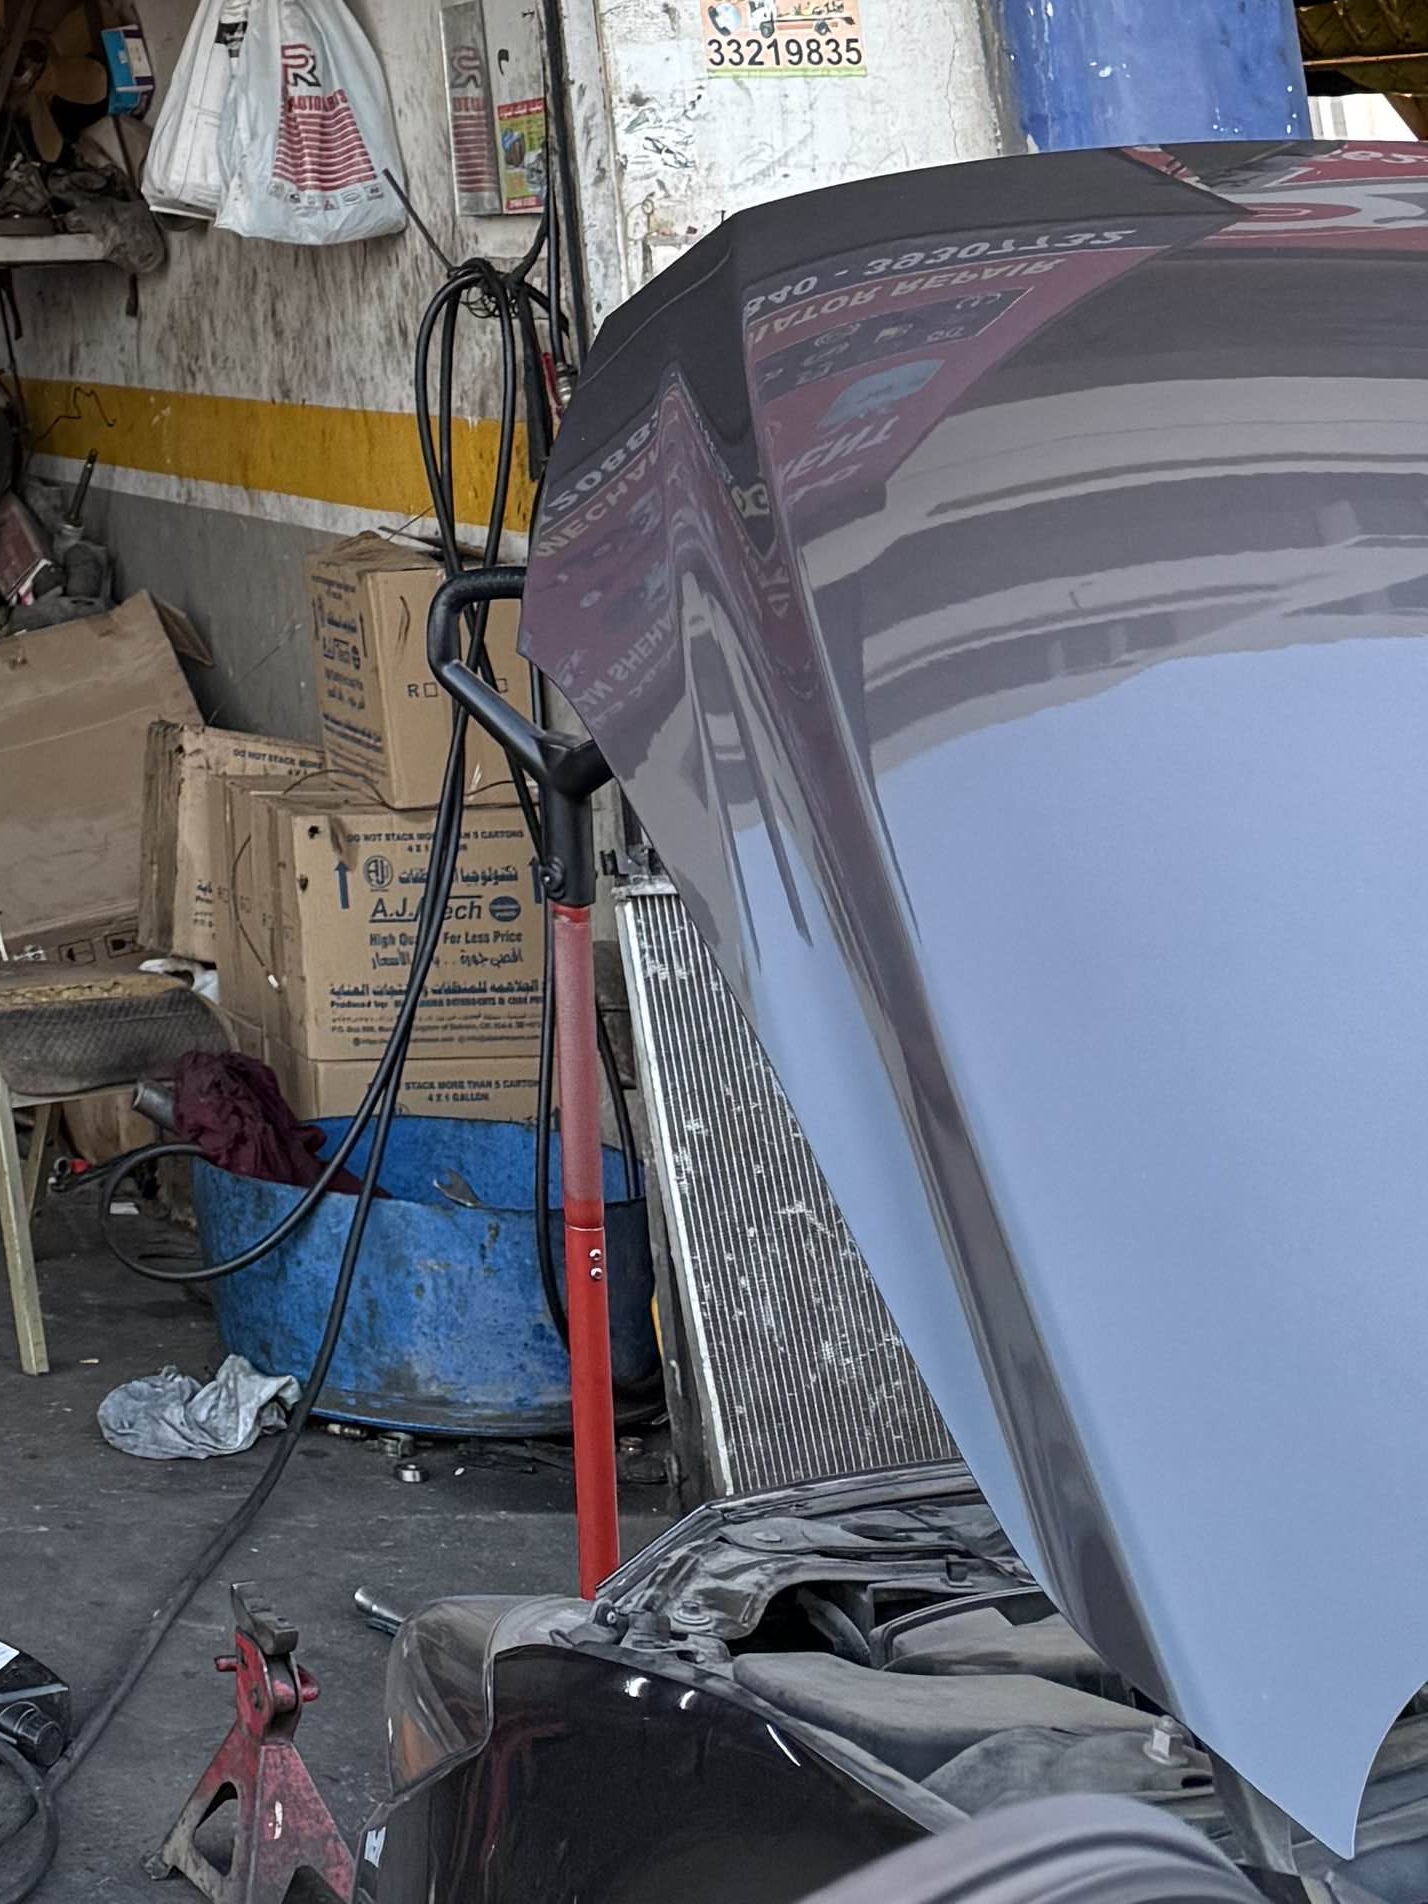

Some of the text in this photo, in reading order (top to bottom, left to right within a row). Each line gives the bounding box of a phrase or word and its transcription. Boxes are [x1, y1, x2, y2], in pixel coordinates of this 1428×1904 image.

[707, 38, 863, 67] 33219835
[369, 932, 395, 947] High
[464, 931, 491, 944] Less
[493, 930, 523, 944] Price
[502, 1078, 540, 1089] CARTON
